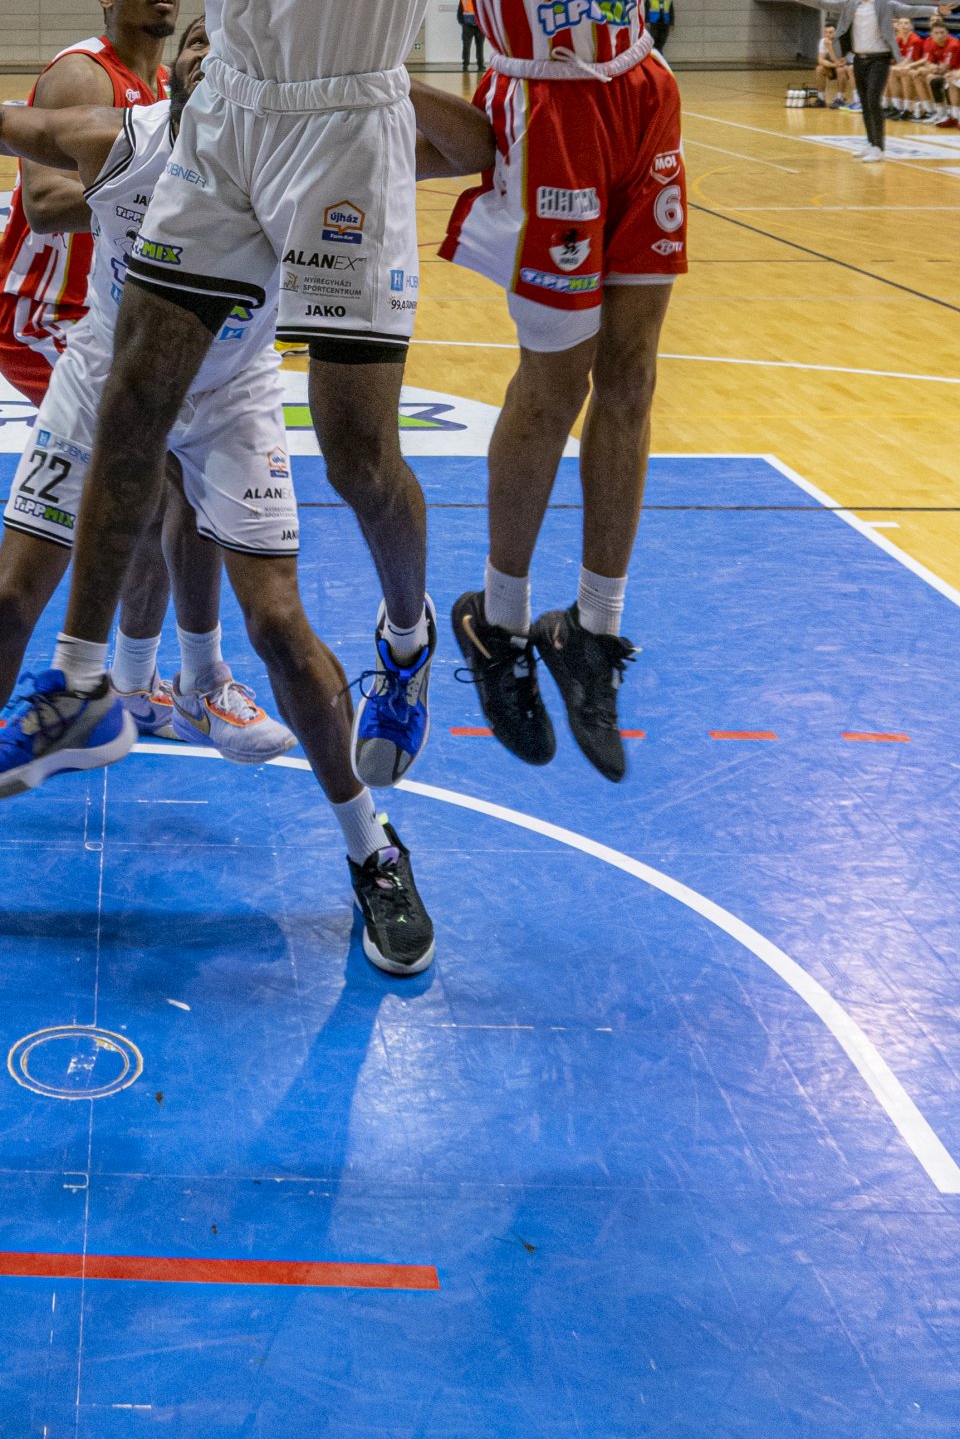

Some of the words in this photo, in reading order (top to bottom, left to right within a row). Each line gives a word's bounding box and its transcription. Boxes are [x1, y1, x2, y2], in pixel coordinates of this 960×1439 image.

[654, 184, 684, 233] 6
[283, 249, 358, 271] ALANEX
[304, 275, 352, 287] NYÍREGYHÁZI
[303, 285, 362, 296] SPORTCENTRUM
[305, 305, 346, 317] JAKO
[19, 449, 71, 504] 22
